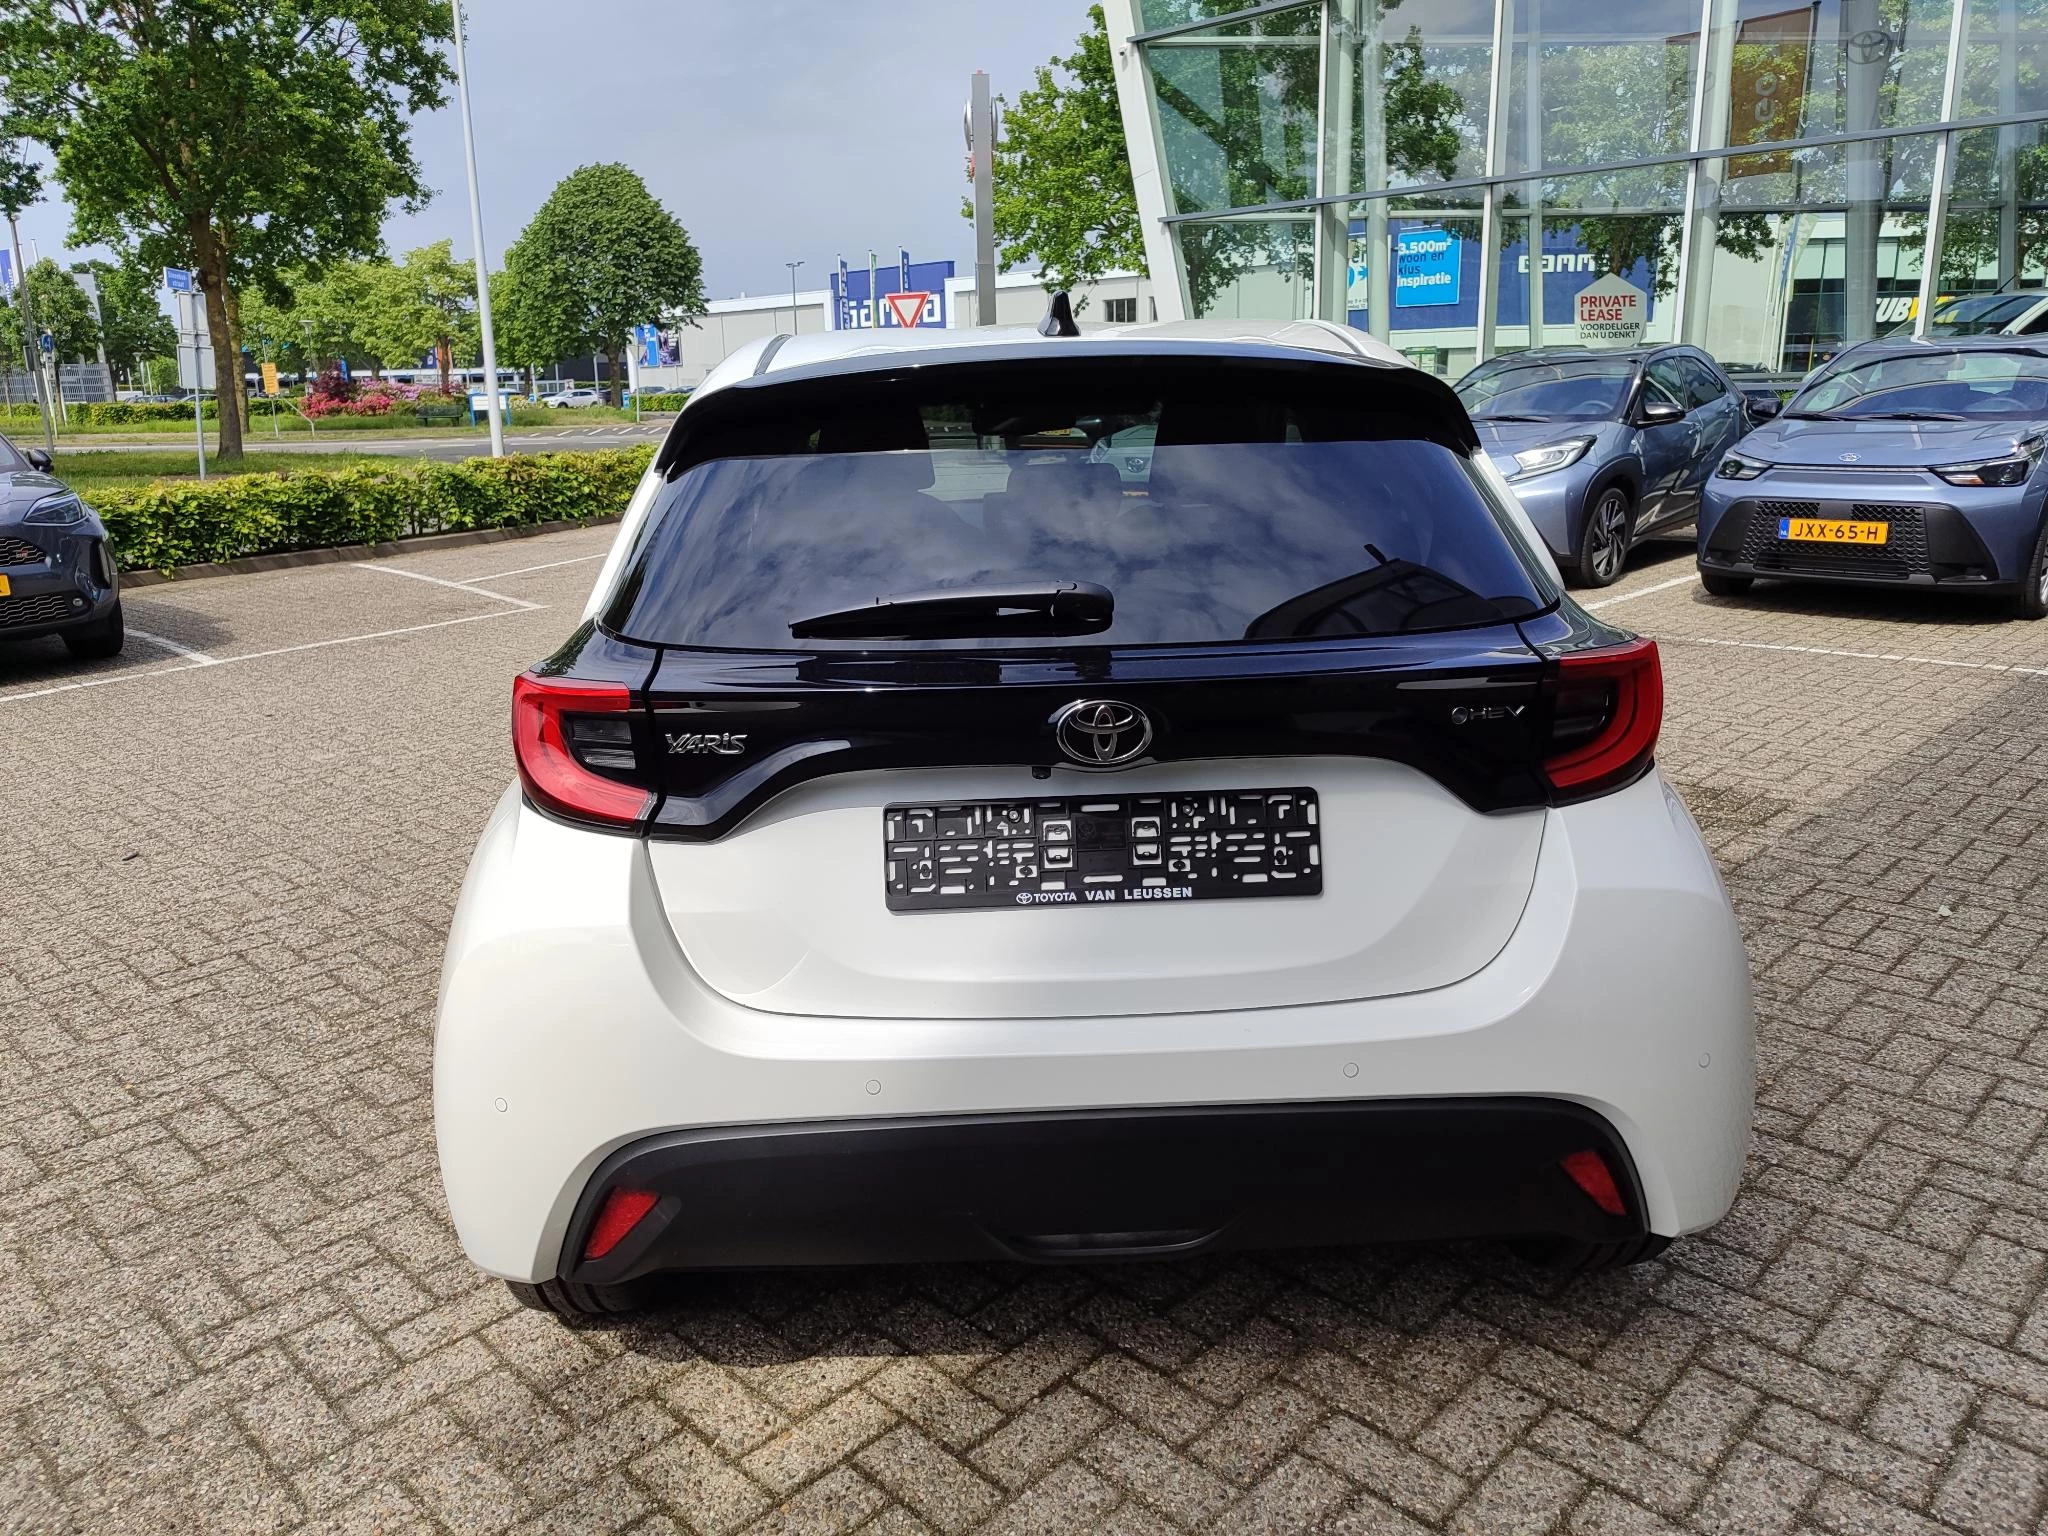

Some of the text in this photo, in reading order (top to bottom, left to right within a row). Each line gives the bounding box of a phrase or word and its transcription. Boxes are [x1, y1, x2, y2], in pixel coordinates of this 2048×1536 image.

[1399, 251, 1445, 263] woon en
[1397, 271, 1452, 288] inspiratie
[1580, 295, 1636, 308] PRIVATE
[1580, 309, 1622, 321] LEASE
[1580, 322, 1640, 331] VOORDELIGER
[1580, 331, 1636, 339] DAN U DENKT
[1795, 523, 1878, 540] JXX-65-H
[1034, 886, 1193, 903] TOYOTA VAN LEUSSEN
